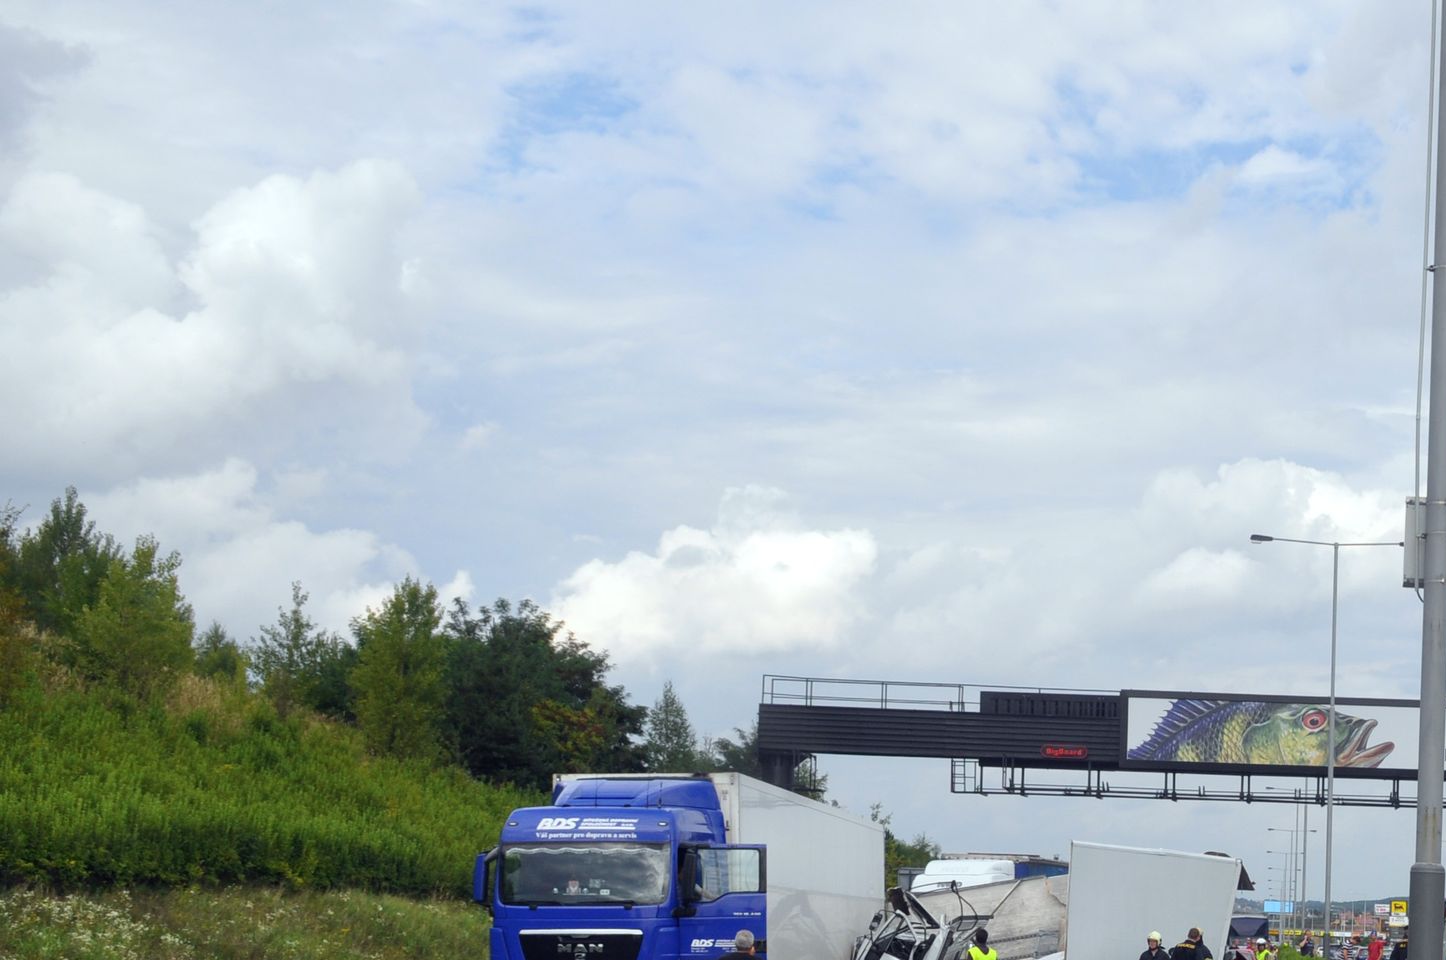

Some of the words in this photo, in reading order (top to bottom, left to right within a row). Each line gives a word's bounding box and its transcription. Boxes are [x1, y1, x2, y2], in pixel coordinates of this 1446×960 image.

[537, 818, 580, 830] BDS
[557, 943, 604, 953] MAN
[690, 939, 715, 948] BDS
